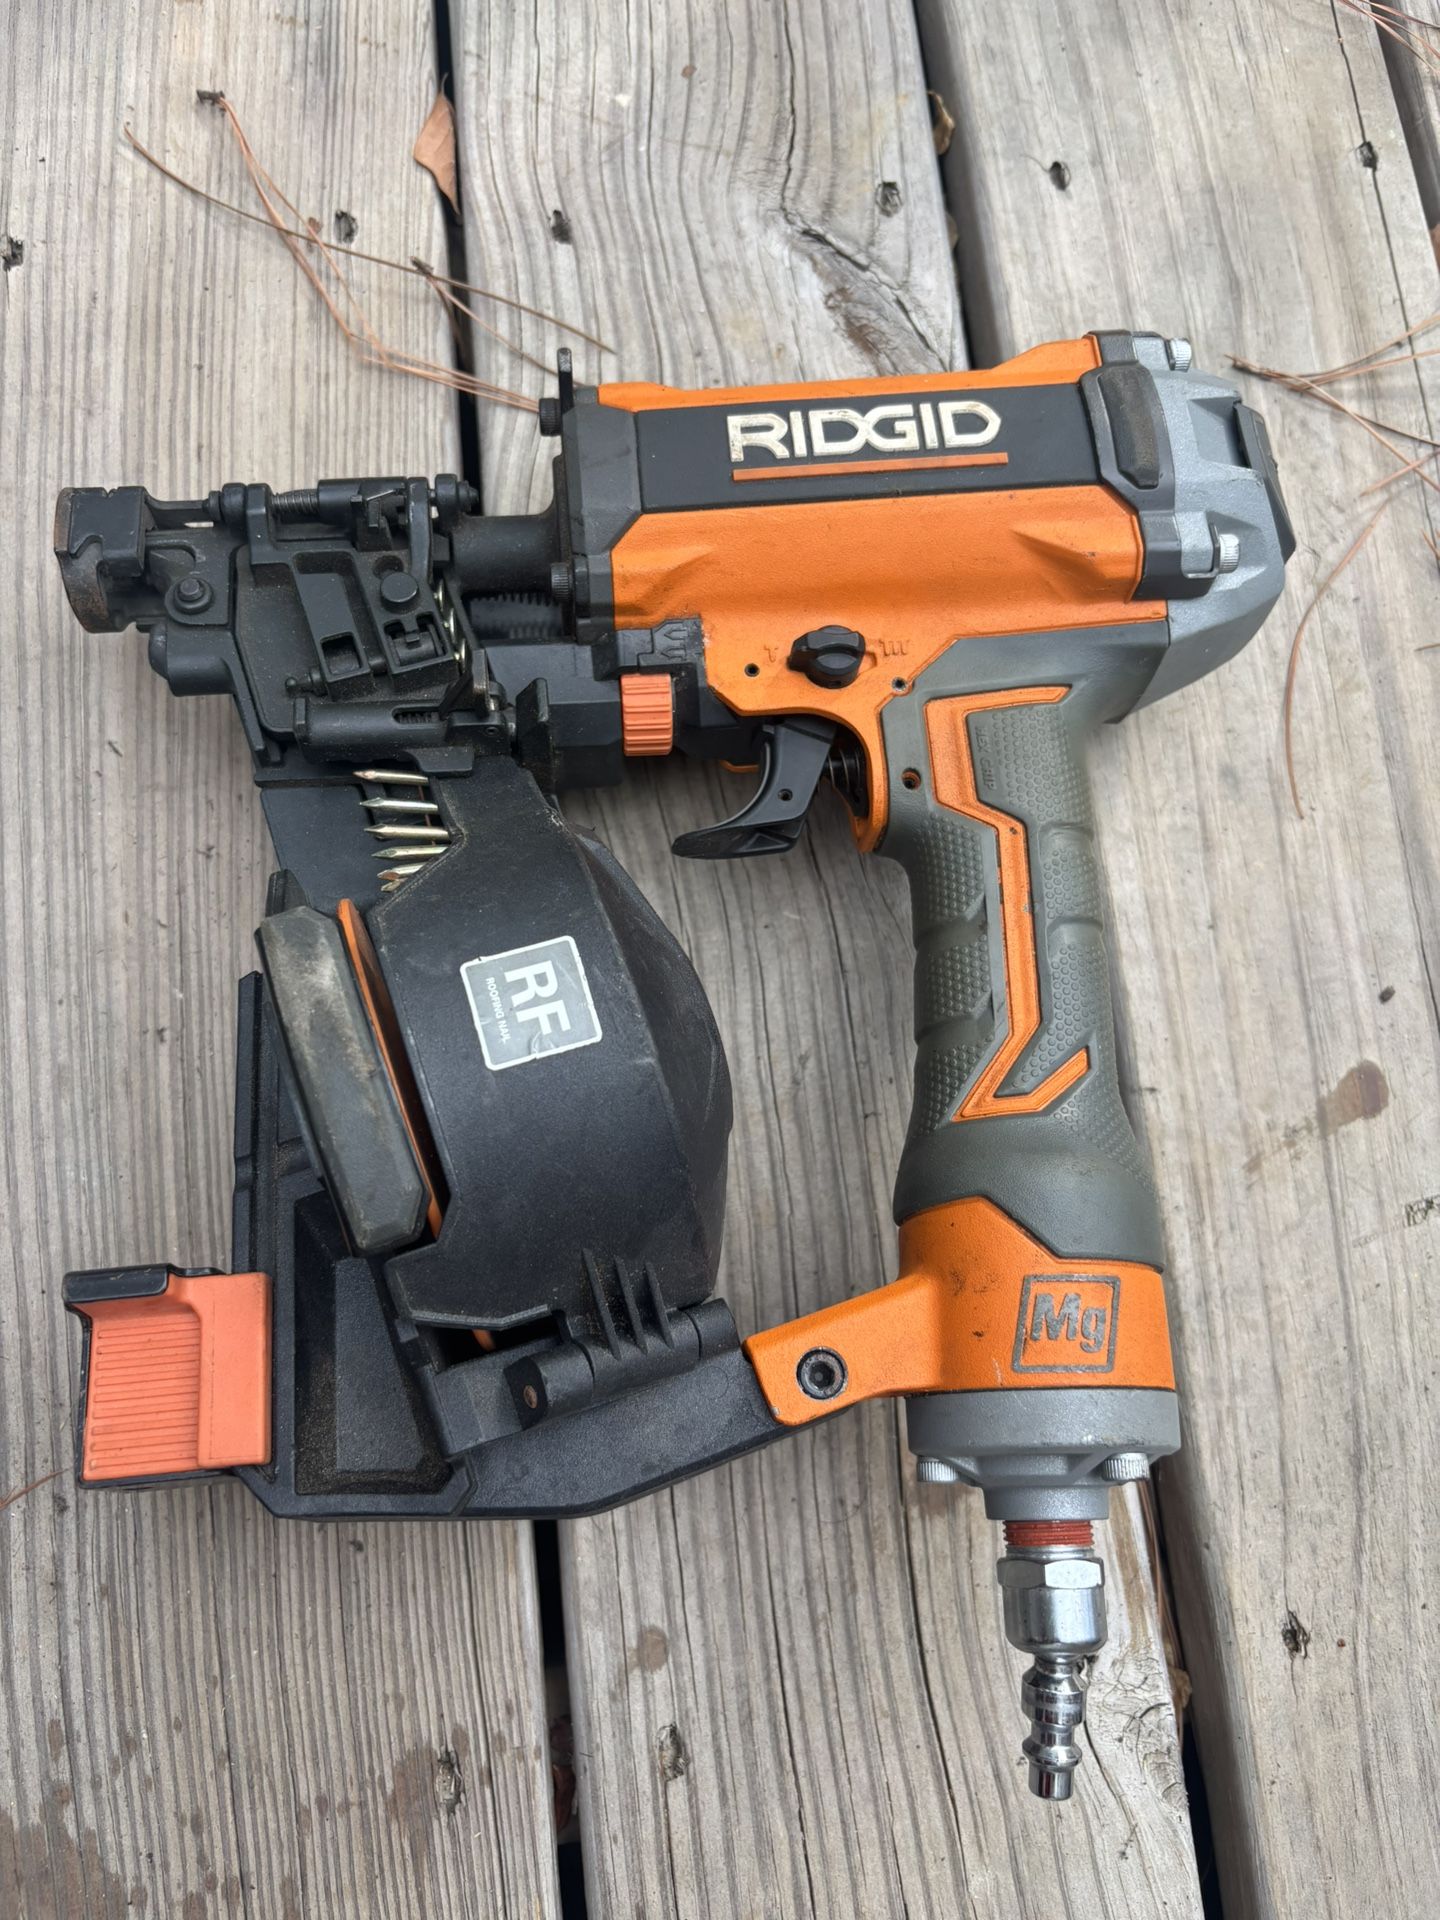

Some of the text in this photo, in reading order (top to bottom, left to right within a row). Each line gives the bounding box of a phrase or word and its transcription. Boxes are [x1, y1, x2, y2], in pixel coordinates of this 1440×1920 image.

[727, 401, 1001, 462] RIDGID
[486, 977, 504, 1018] ROOFING
[504, 960, 571, 1036] RF
[1030, 1293, 1107, 1353] Mg
